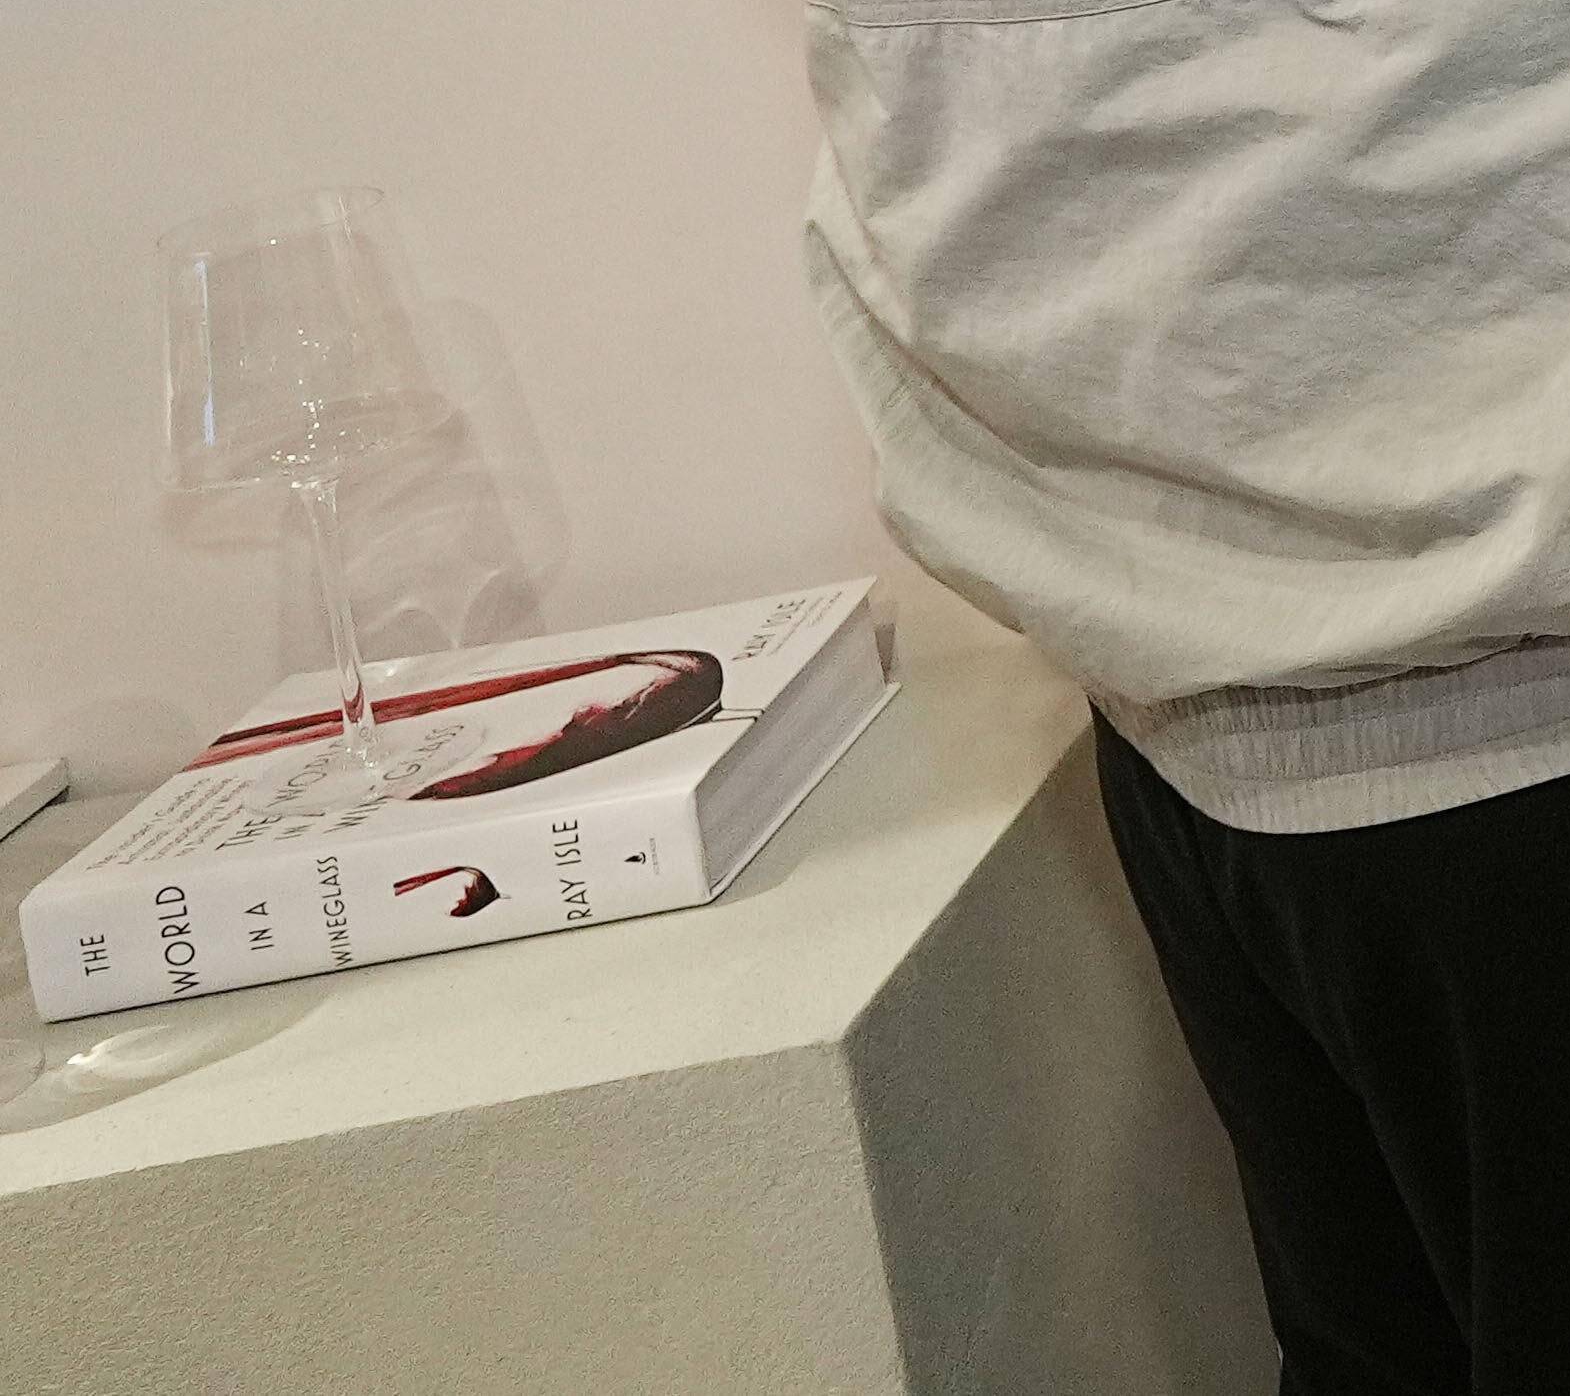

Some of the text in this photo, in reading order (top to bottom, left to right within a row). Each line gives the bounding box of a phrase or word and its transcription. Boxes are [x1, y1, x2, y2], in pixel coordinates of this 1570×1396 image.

[215, 815, 286, 850] THE
[552, 819, 593, 922] RAY ISLE
[155, 886, 200, 994] WORLD
[245, 900, 275, 950] IN A
[316, 854, 354, 967] WINEGLASS
[80, 933, 111, 976] THE
